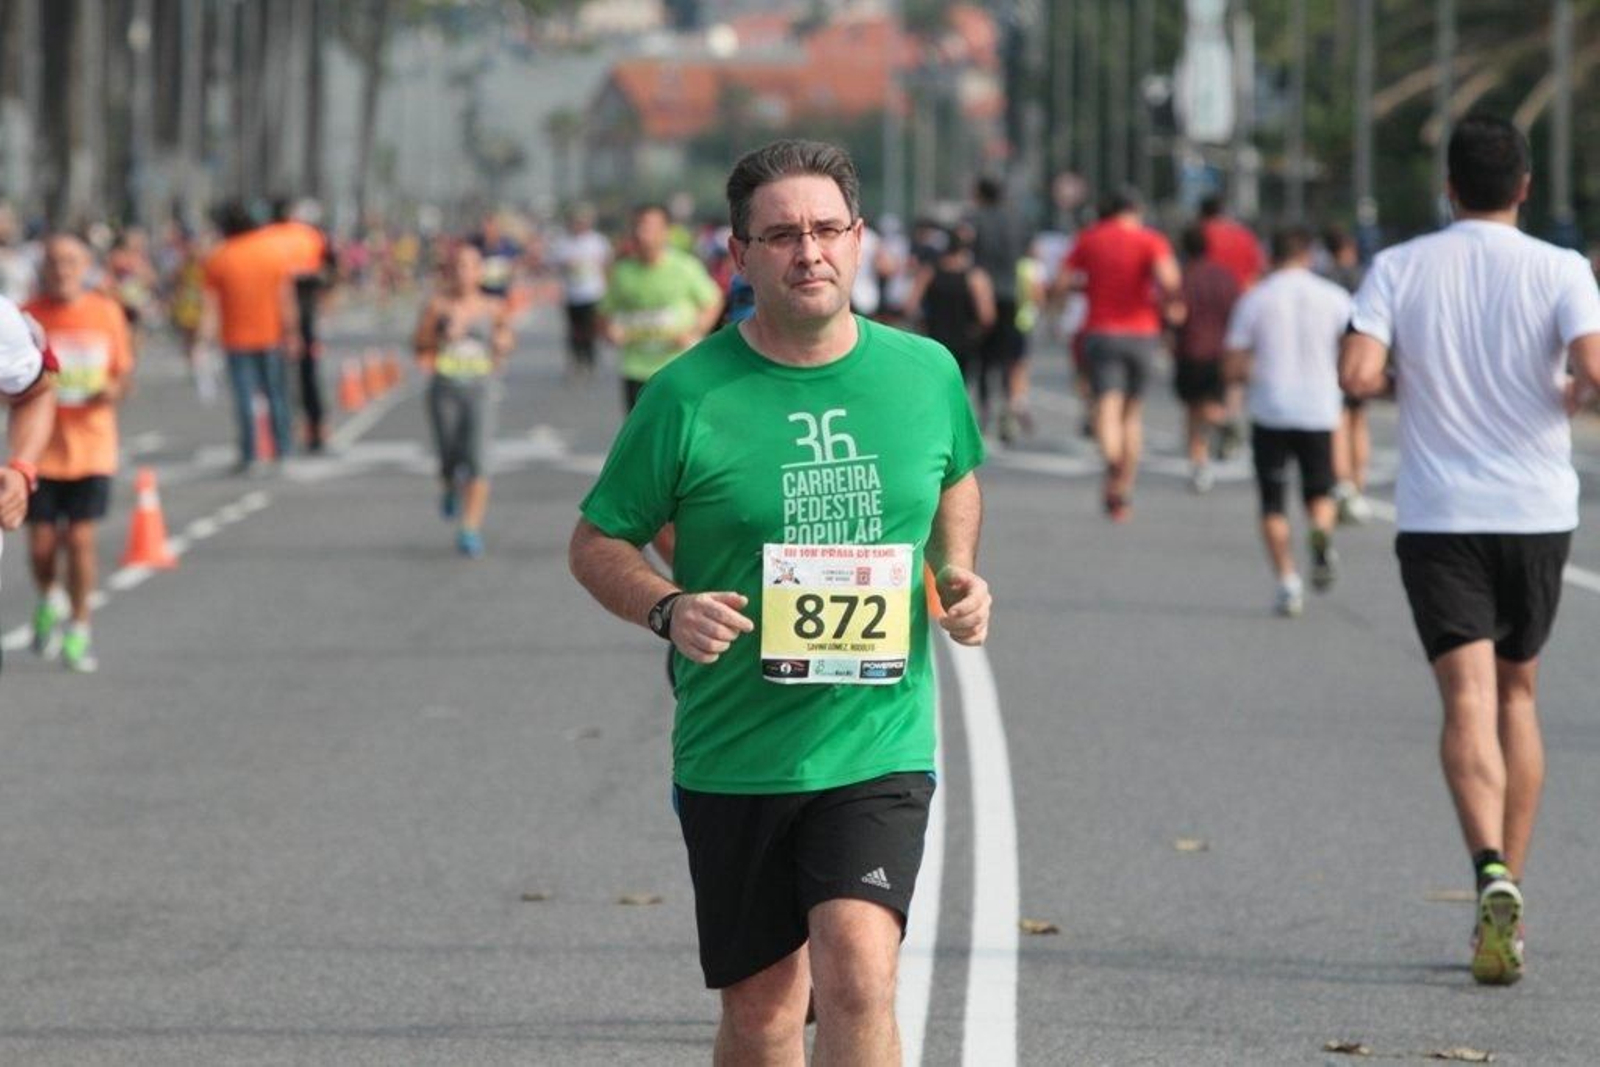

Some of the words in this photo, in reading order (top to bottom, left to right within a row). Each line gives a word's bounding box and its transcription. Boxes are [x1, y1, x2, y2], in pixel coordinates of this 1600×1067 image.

[788, 408, 857, 463] 36
[782, 463, 882, 498] CARREIRA
[783, 489, 883, 525] PEDESTRE
[783, 516, 882, 545] POPULAR
[794, 593, 887, 640] 872
